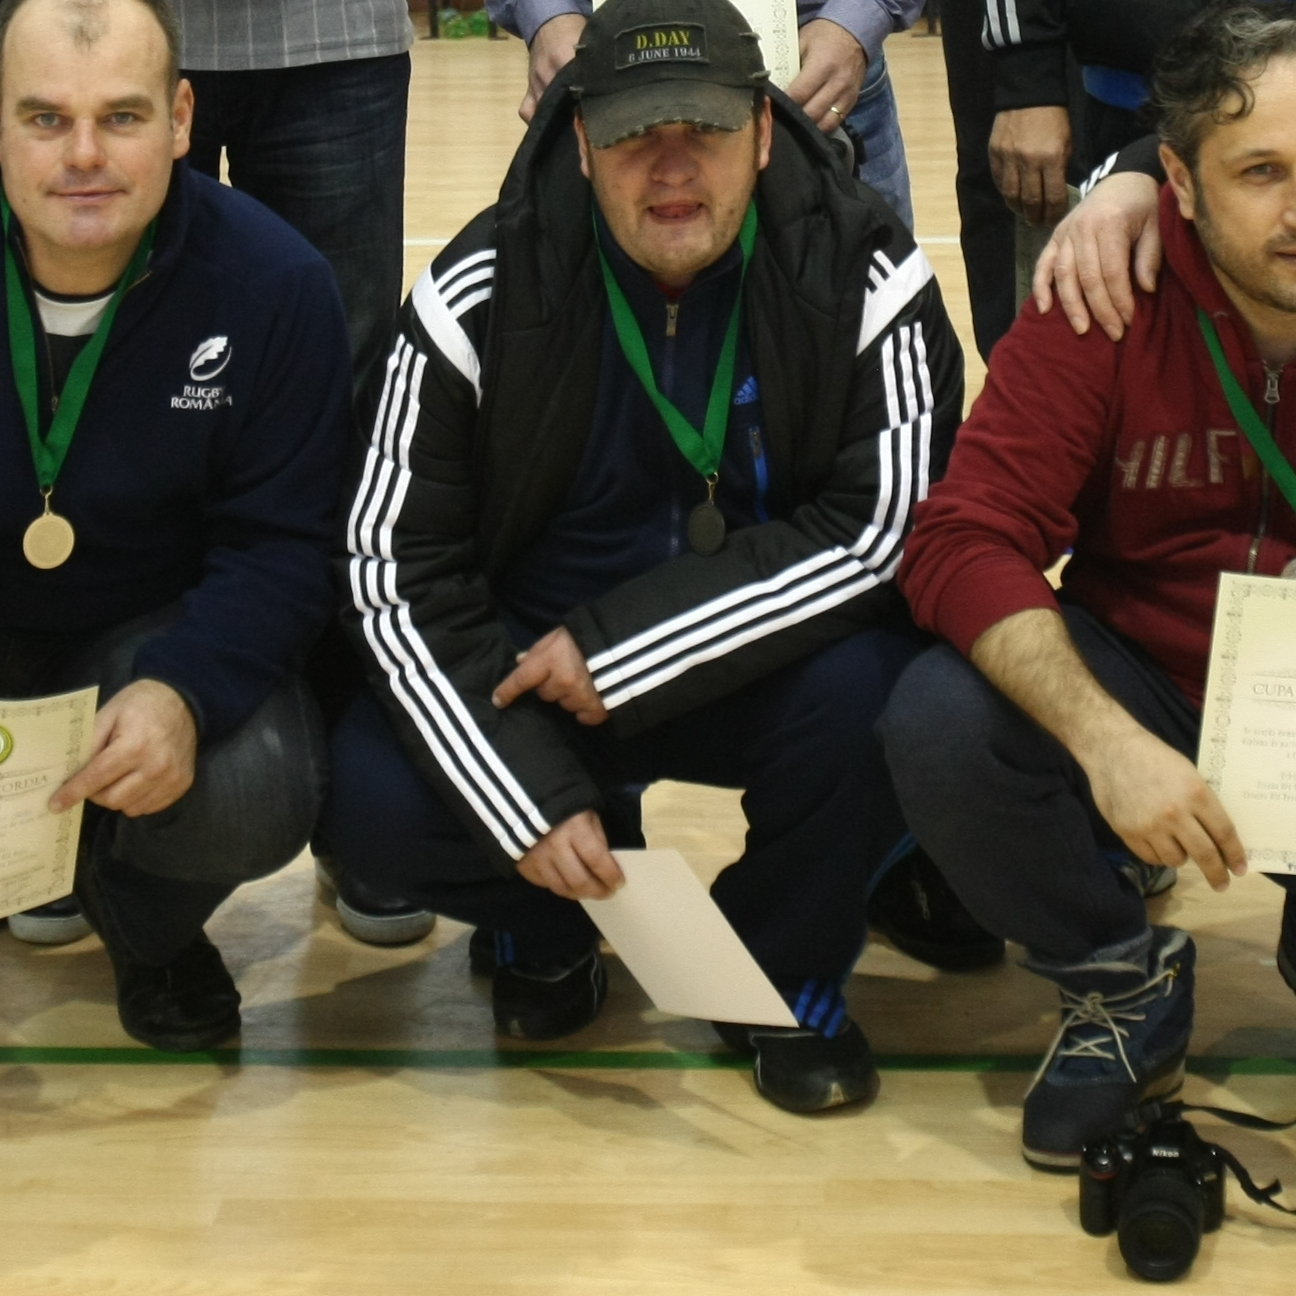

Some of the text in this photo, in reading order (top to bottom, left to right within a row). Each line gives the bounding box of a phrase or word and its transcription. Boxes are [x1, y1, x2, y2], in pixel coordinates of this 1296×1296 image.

[636, 30, 690, 50] D.DAY
[628, 47, 701, 63] 6 JUNE 1944
[1253, 682, 1293, 697] CUPA
[1151, 1147, 1180, 1158] Nikon
